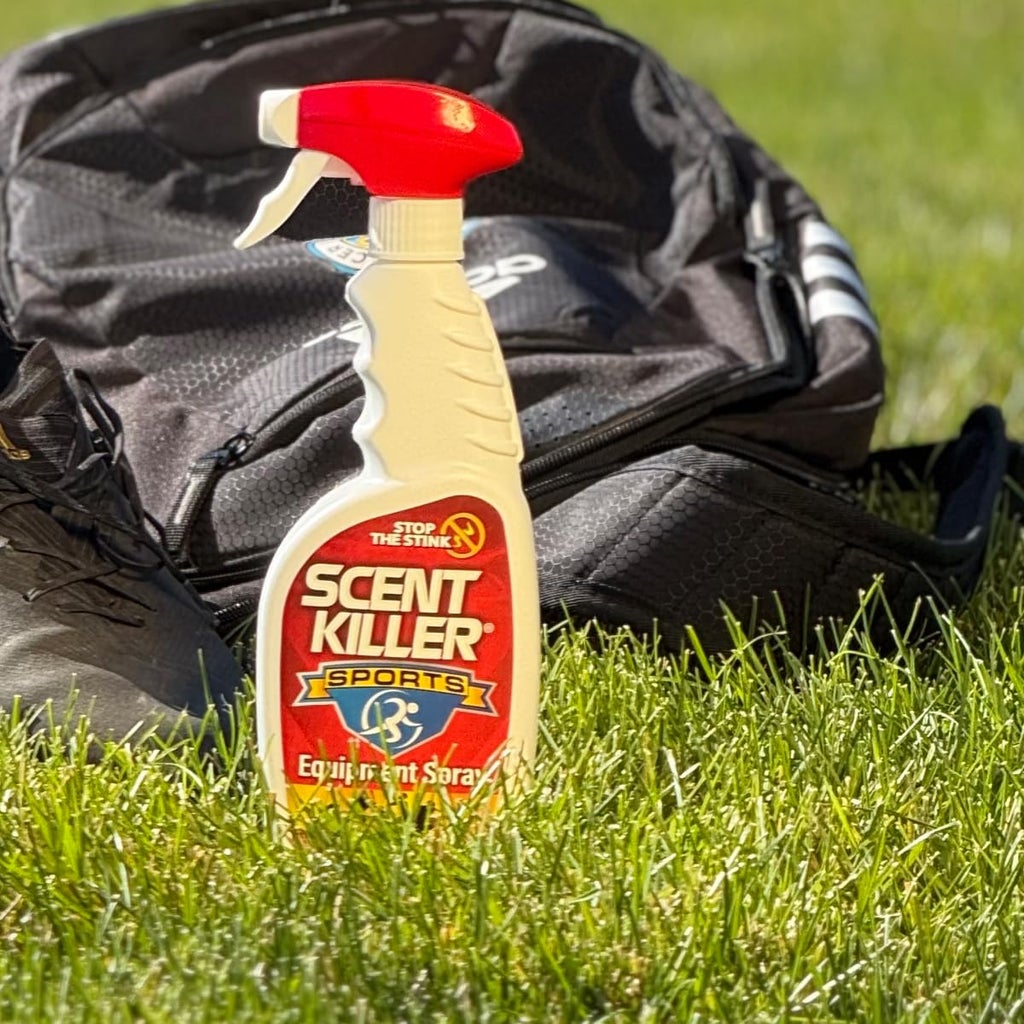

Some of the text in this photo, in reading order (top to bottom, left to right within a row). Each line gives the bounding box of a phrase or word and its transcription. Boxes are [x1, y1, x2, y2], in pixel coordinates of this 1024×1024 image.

[393, 521, 437, 535] STOP
[369, 532, 454, 549] THE STINK
[300, 563, 484, 615] SCENT
[327, 668, 465, 694] SPORTS
